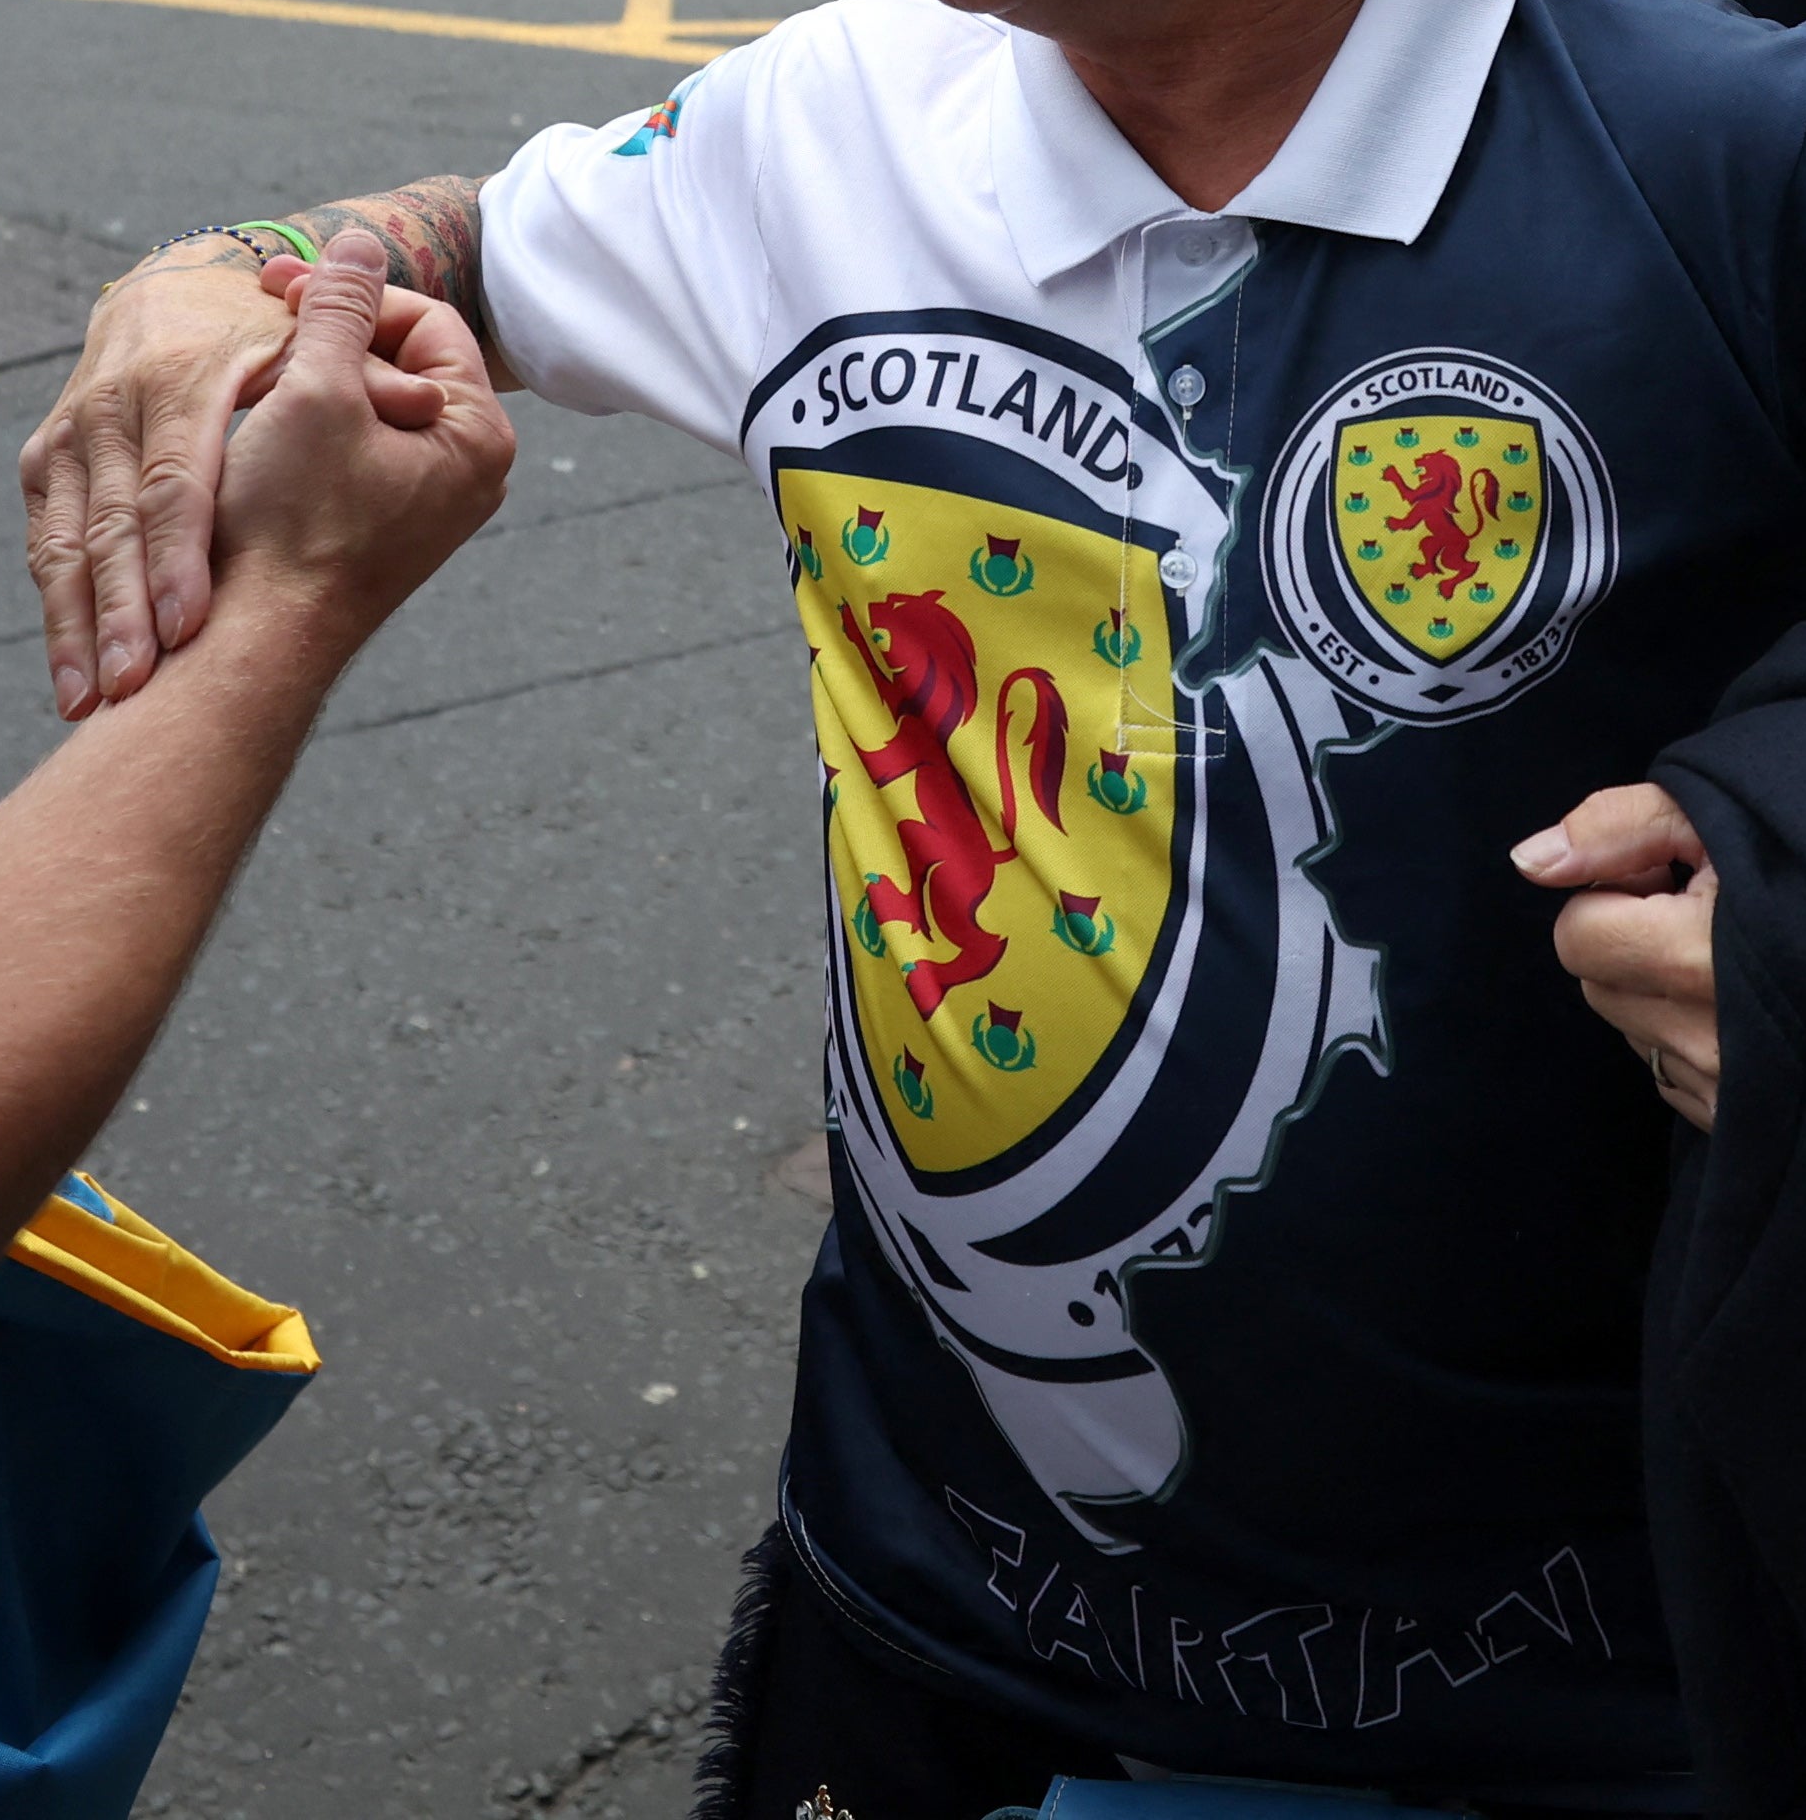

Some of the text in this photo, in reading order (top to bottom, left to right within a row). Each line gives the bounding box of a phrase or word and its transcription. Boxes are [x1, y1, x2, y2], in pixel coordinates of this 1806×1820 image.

[1365, 367, 1510, 406] SCOTLAND
[817, 347, 1132, 483] SCOTLAND
[1316, 631, 1365, 677] EST
[1511, 627, 1561, 675] 1873
